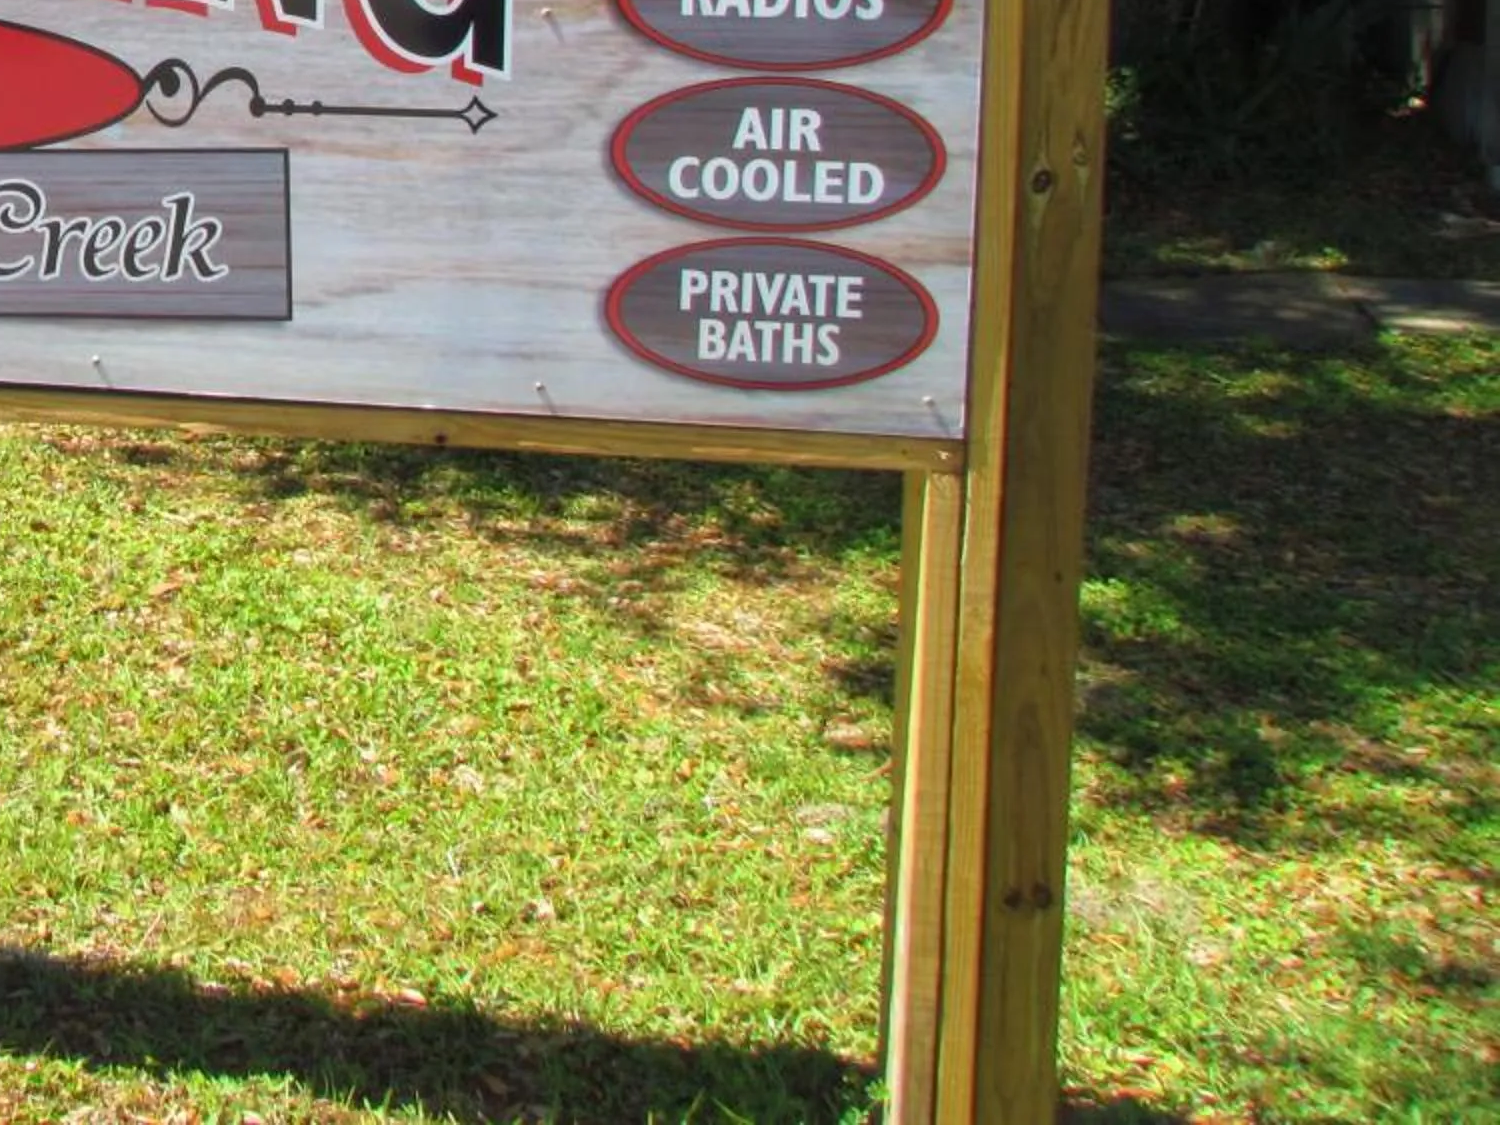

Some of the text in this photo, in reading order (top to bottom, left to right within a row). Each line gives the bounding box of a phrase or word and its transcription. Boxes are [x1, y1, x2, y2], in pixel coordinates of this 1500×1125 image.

[732, 107, 822, 152] AIR
[668, 156, 885, 205] COOLED
[678, 267, 864, 319] PRIVATE
[697, 318, 841, 366] BATHS
